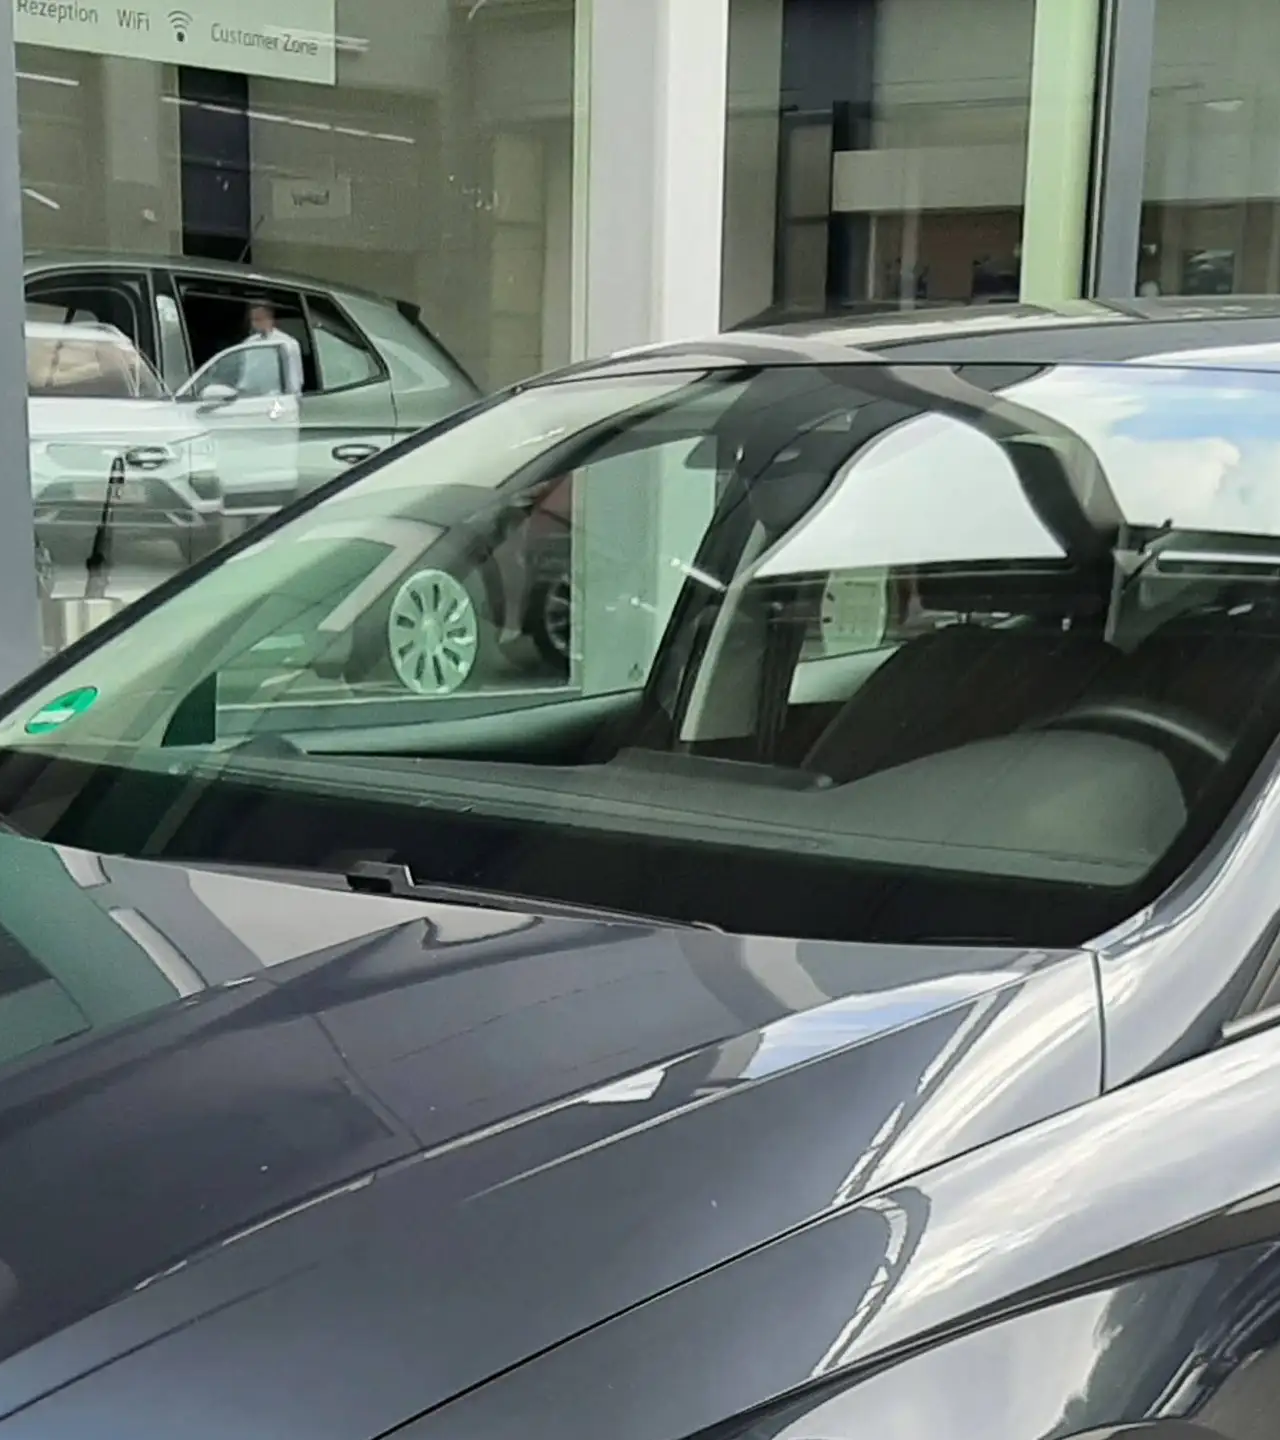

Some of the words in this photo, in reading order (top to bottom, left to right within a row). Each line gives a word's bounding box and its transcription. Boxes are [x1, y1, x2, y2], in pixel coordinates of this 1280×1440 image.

[16, 0, 99, 24] Rezeption
[117, 8, 150, 31] WiFi
[211, 22, 278, 50] Customer
[281, 33, 319, 56] Zone
